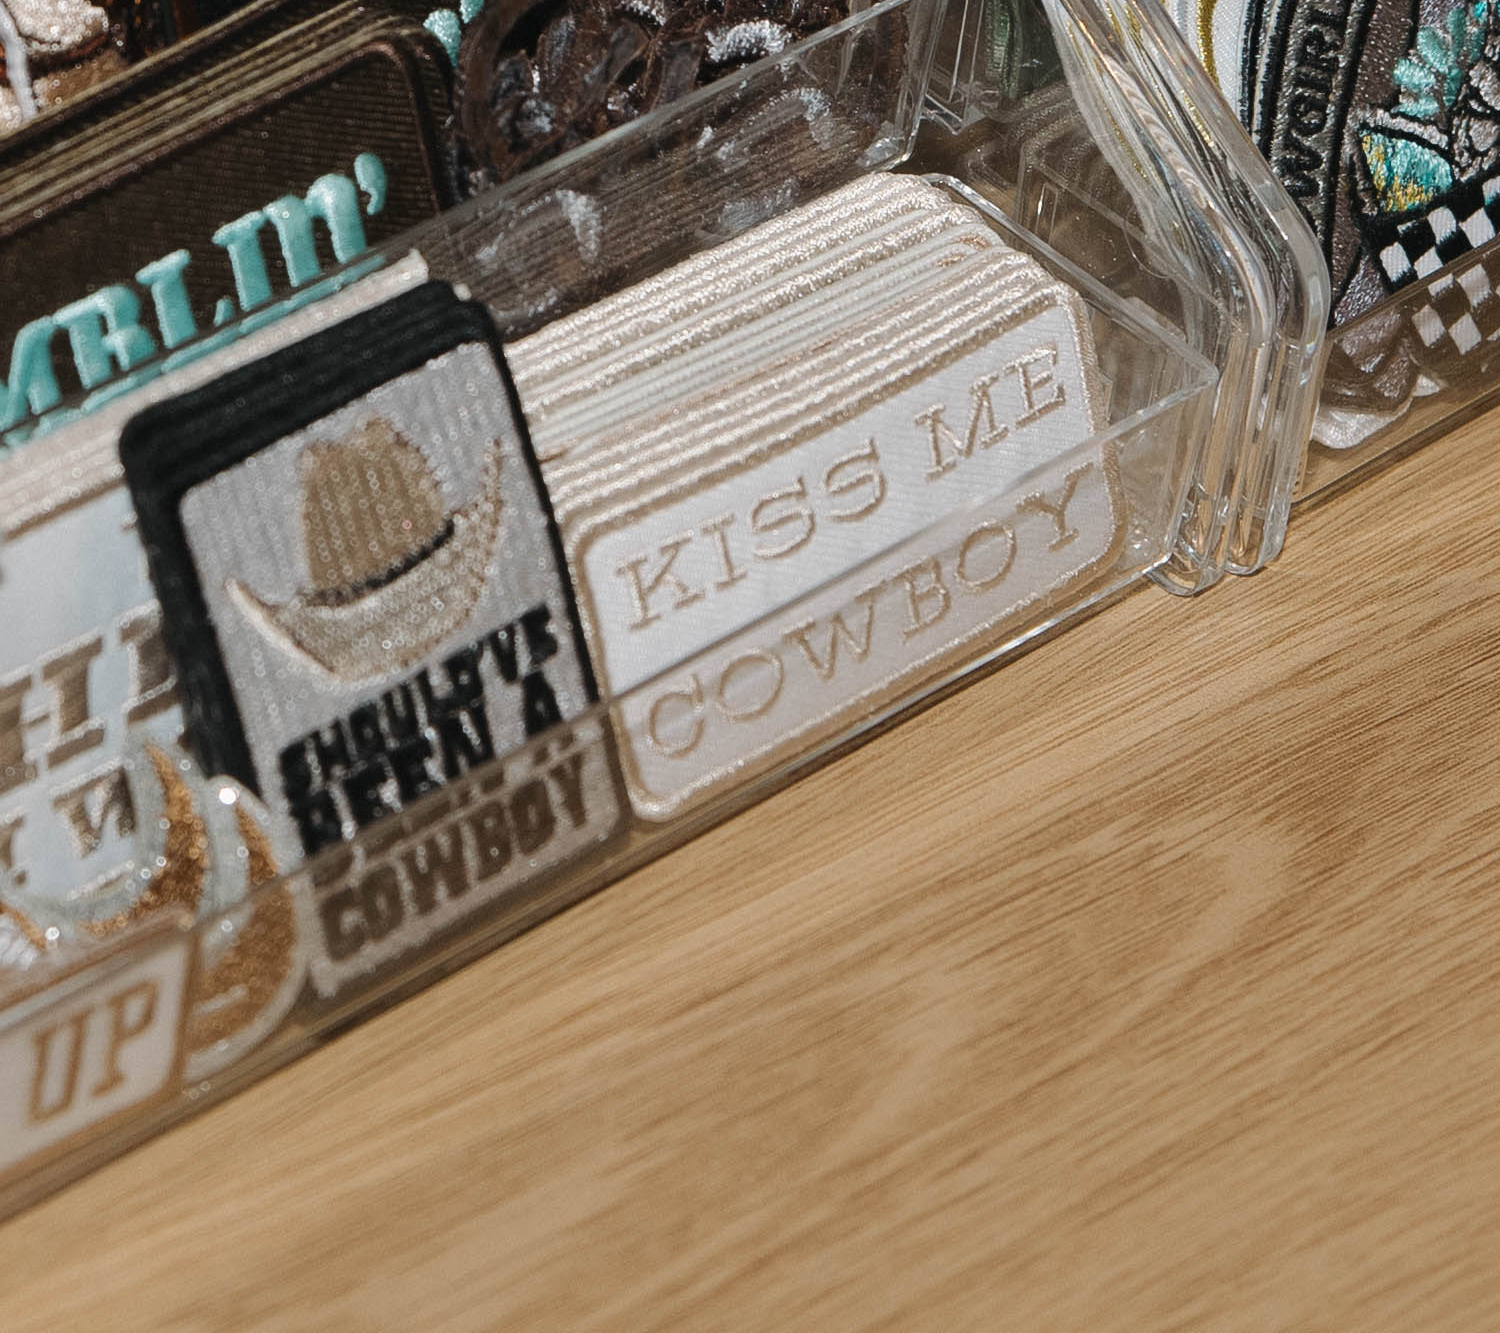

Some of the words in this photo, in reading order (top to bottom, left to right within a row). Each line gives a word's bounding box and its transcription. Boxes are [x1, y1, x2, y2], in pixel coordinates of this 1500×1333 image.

[614, 438, 888, 632] KISS
[914, 340, 1067, 482] ME
[645, 461, 1096, 759] COWBOY
[318, 750, 592, 962] COWBOY
[27, 977, 159, 1125] UP
